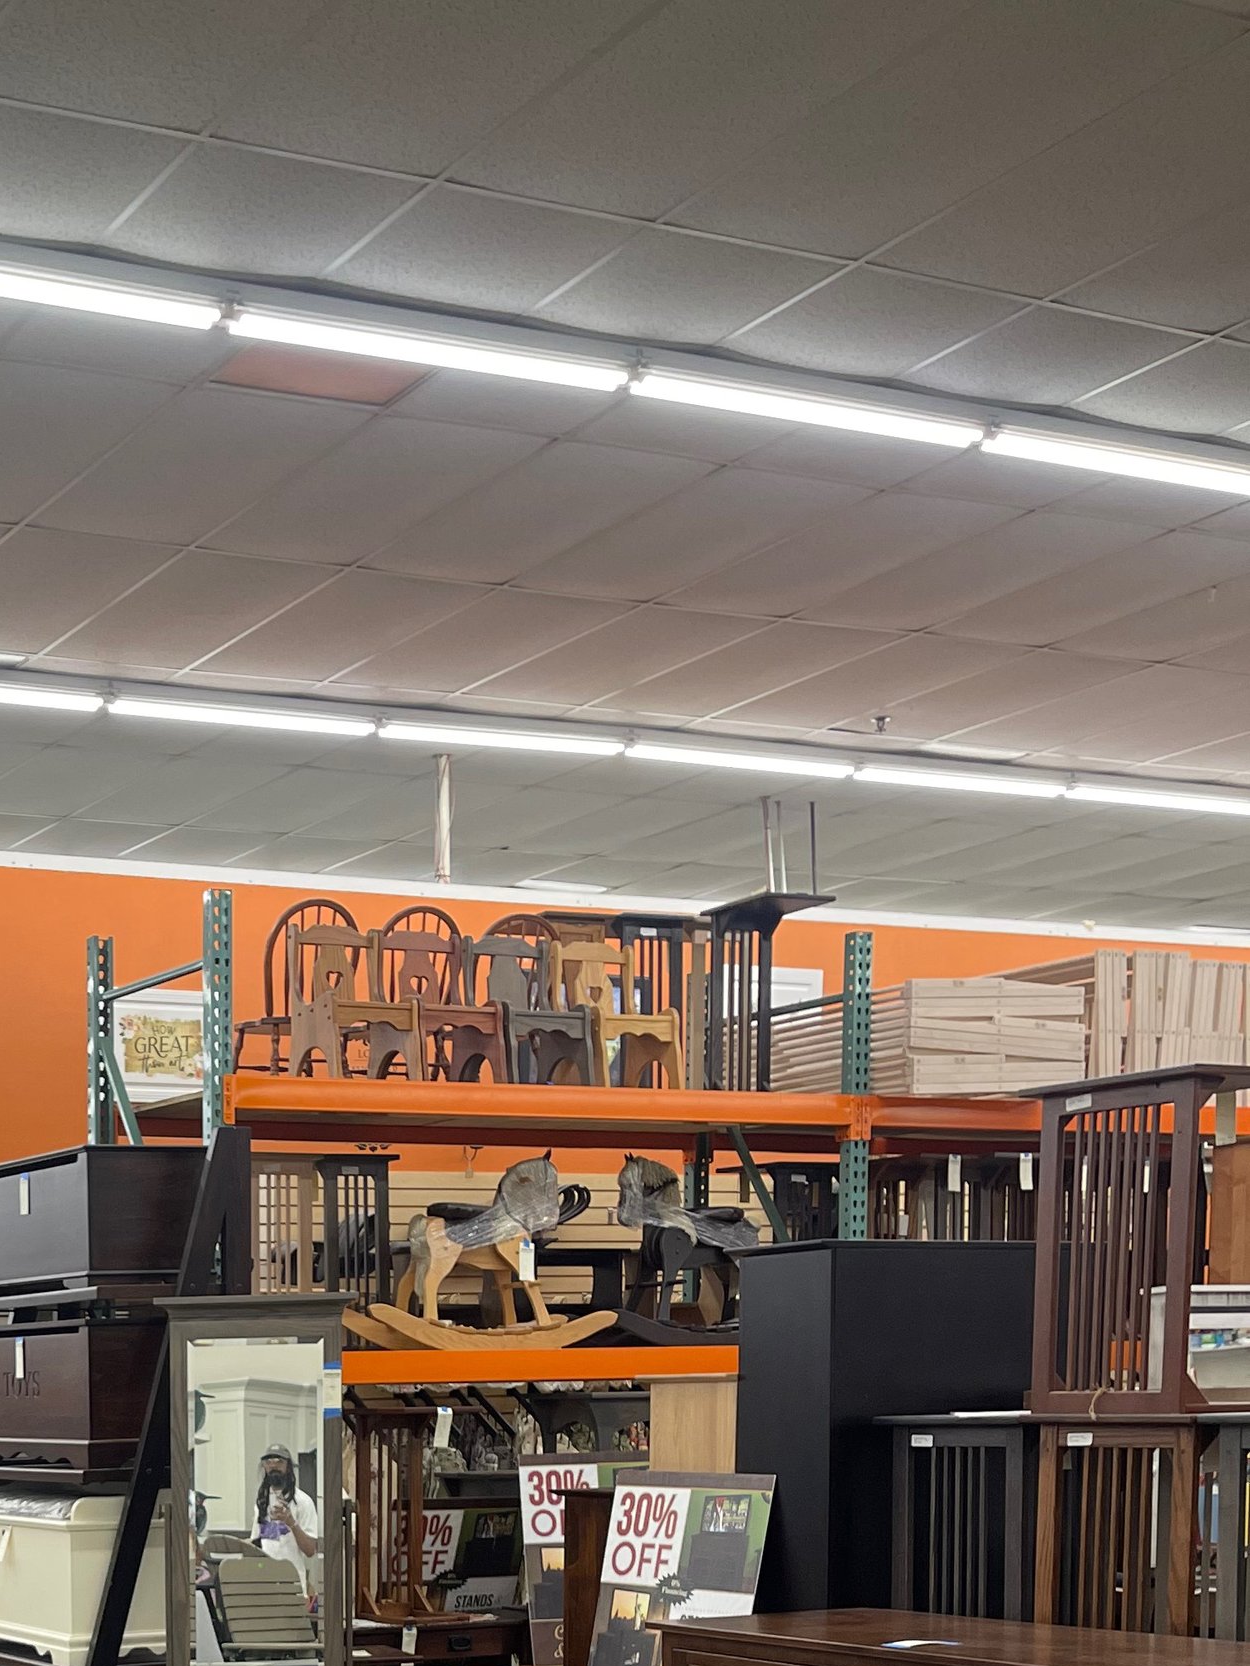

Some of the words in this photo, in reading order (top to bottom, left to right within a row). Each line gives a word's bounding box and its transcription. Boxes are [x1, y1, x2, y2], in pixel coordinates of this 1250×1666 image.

[134, 1035, 194, 1058] GREAT
[3, 1371, 40, 1397] TOYS
[616, 1491, 679, 1540] 30%
[611, 1541, 673, 1578] OFF
[454, 1593, 495, 1609] STANDS
